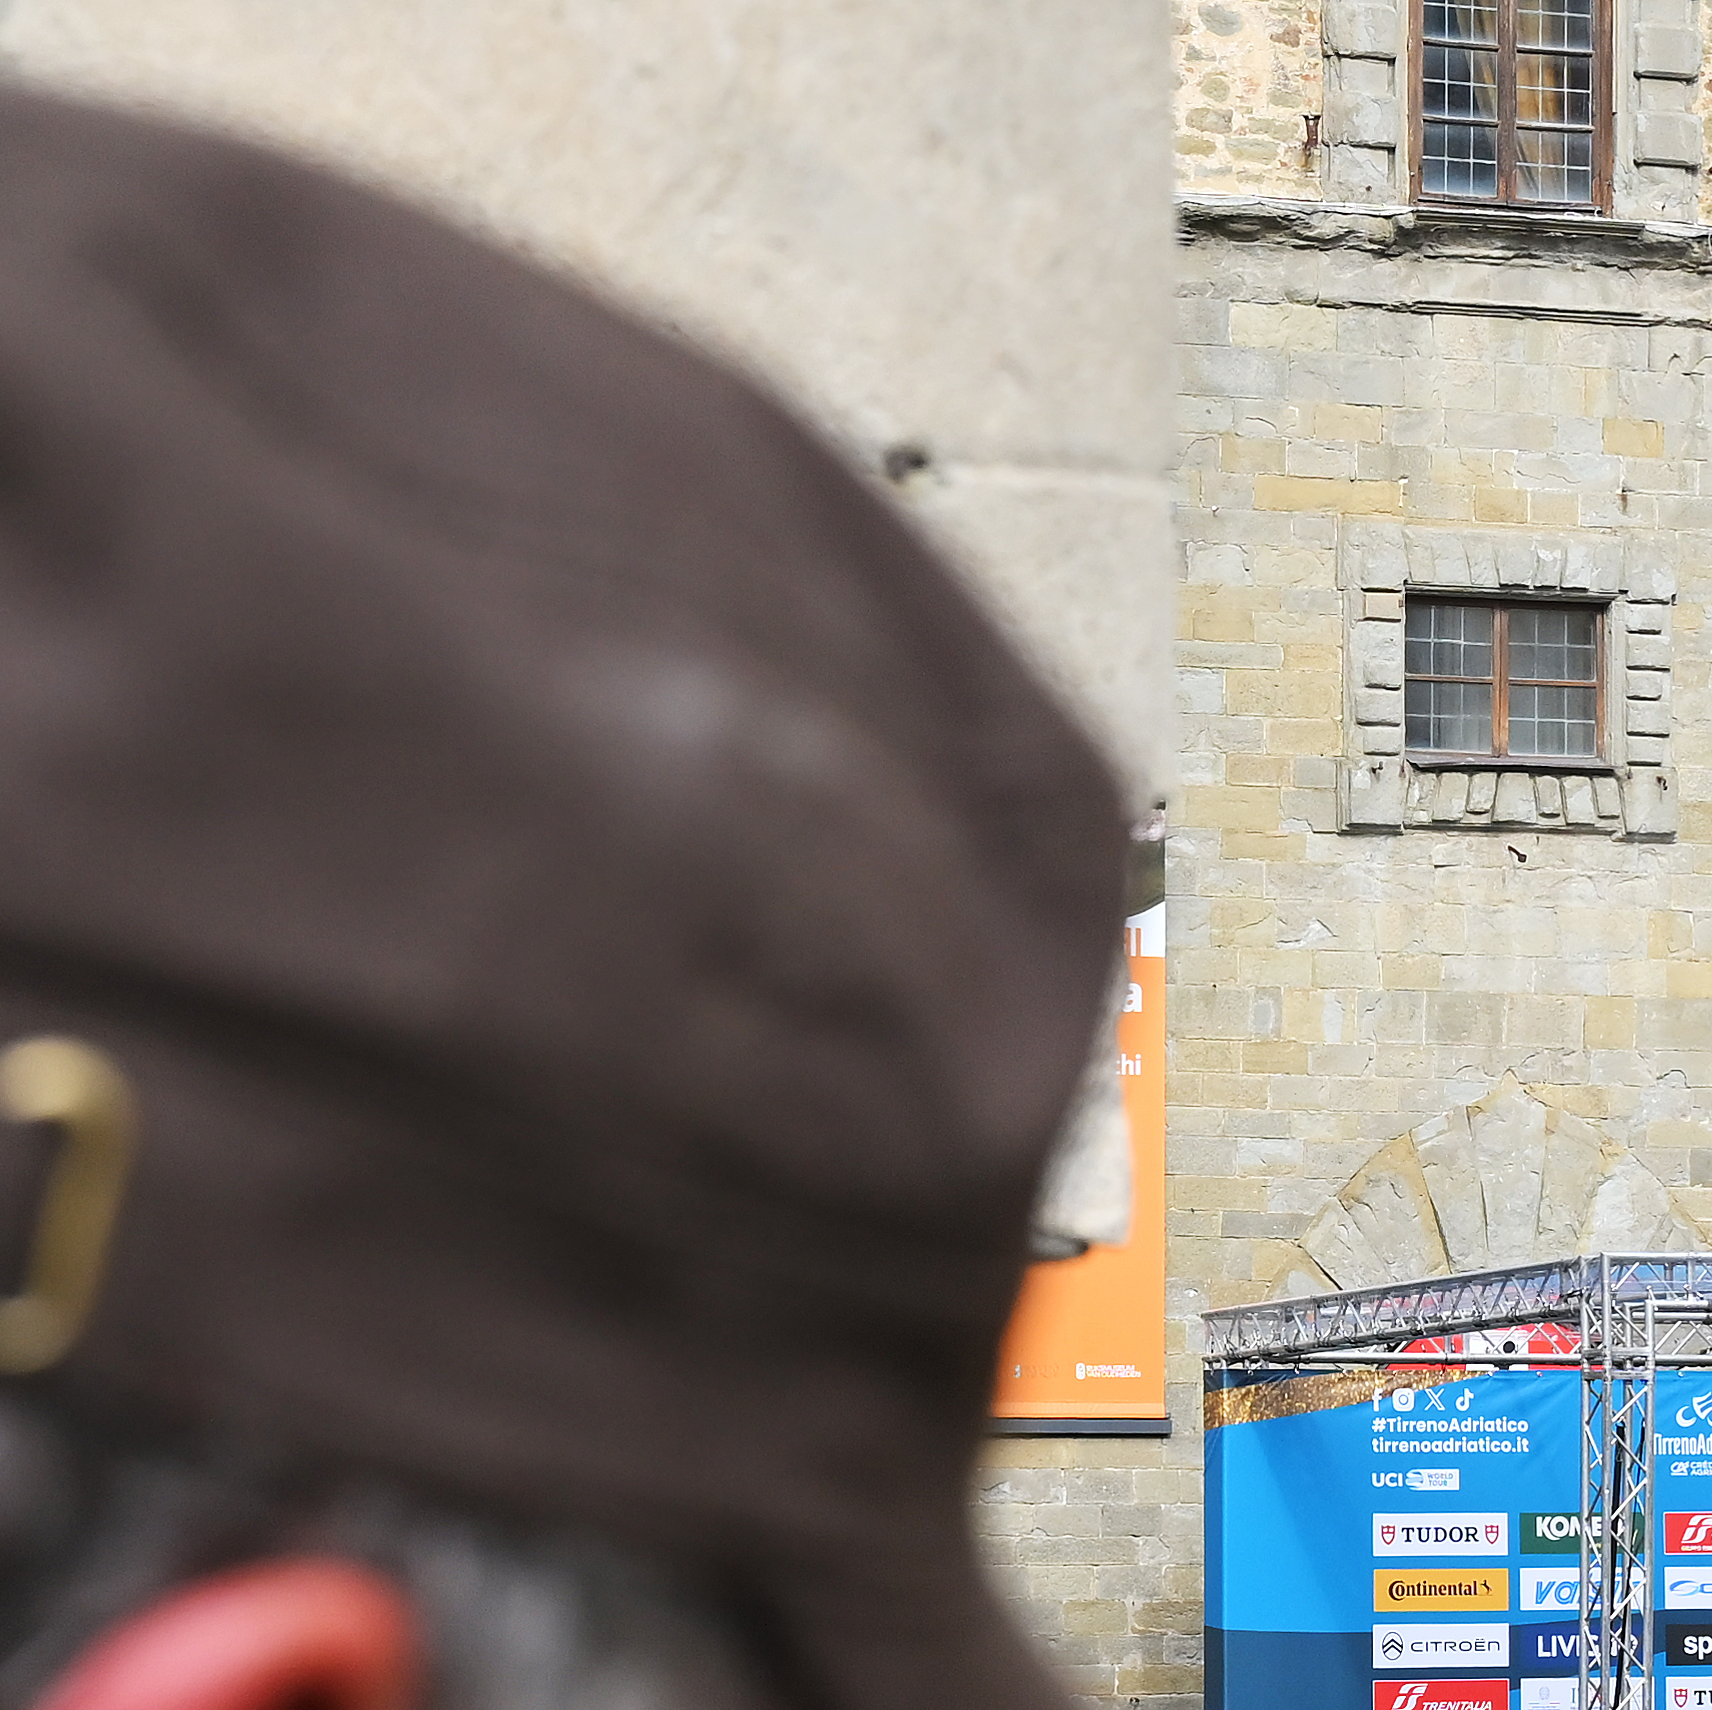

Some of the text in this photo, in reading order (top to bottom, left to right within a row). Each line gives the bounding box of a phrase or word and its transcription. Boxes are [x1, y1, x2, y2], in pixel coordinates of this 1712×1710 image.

[1371, 1416, 1530, 1433] #TirrenoAdriatico
[1371, 1436, 1530, 1453] tirrenoadriatico.it
[1371, 1472, 1404, 1488] UCI
[1401, 1526, 1480, 1543] TUDOR
[1388, 1579, 1479, 1601] Continental
[1410, 1638, 1501, 1652] CITROËN
